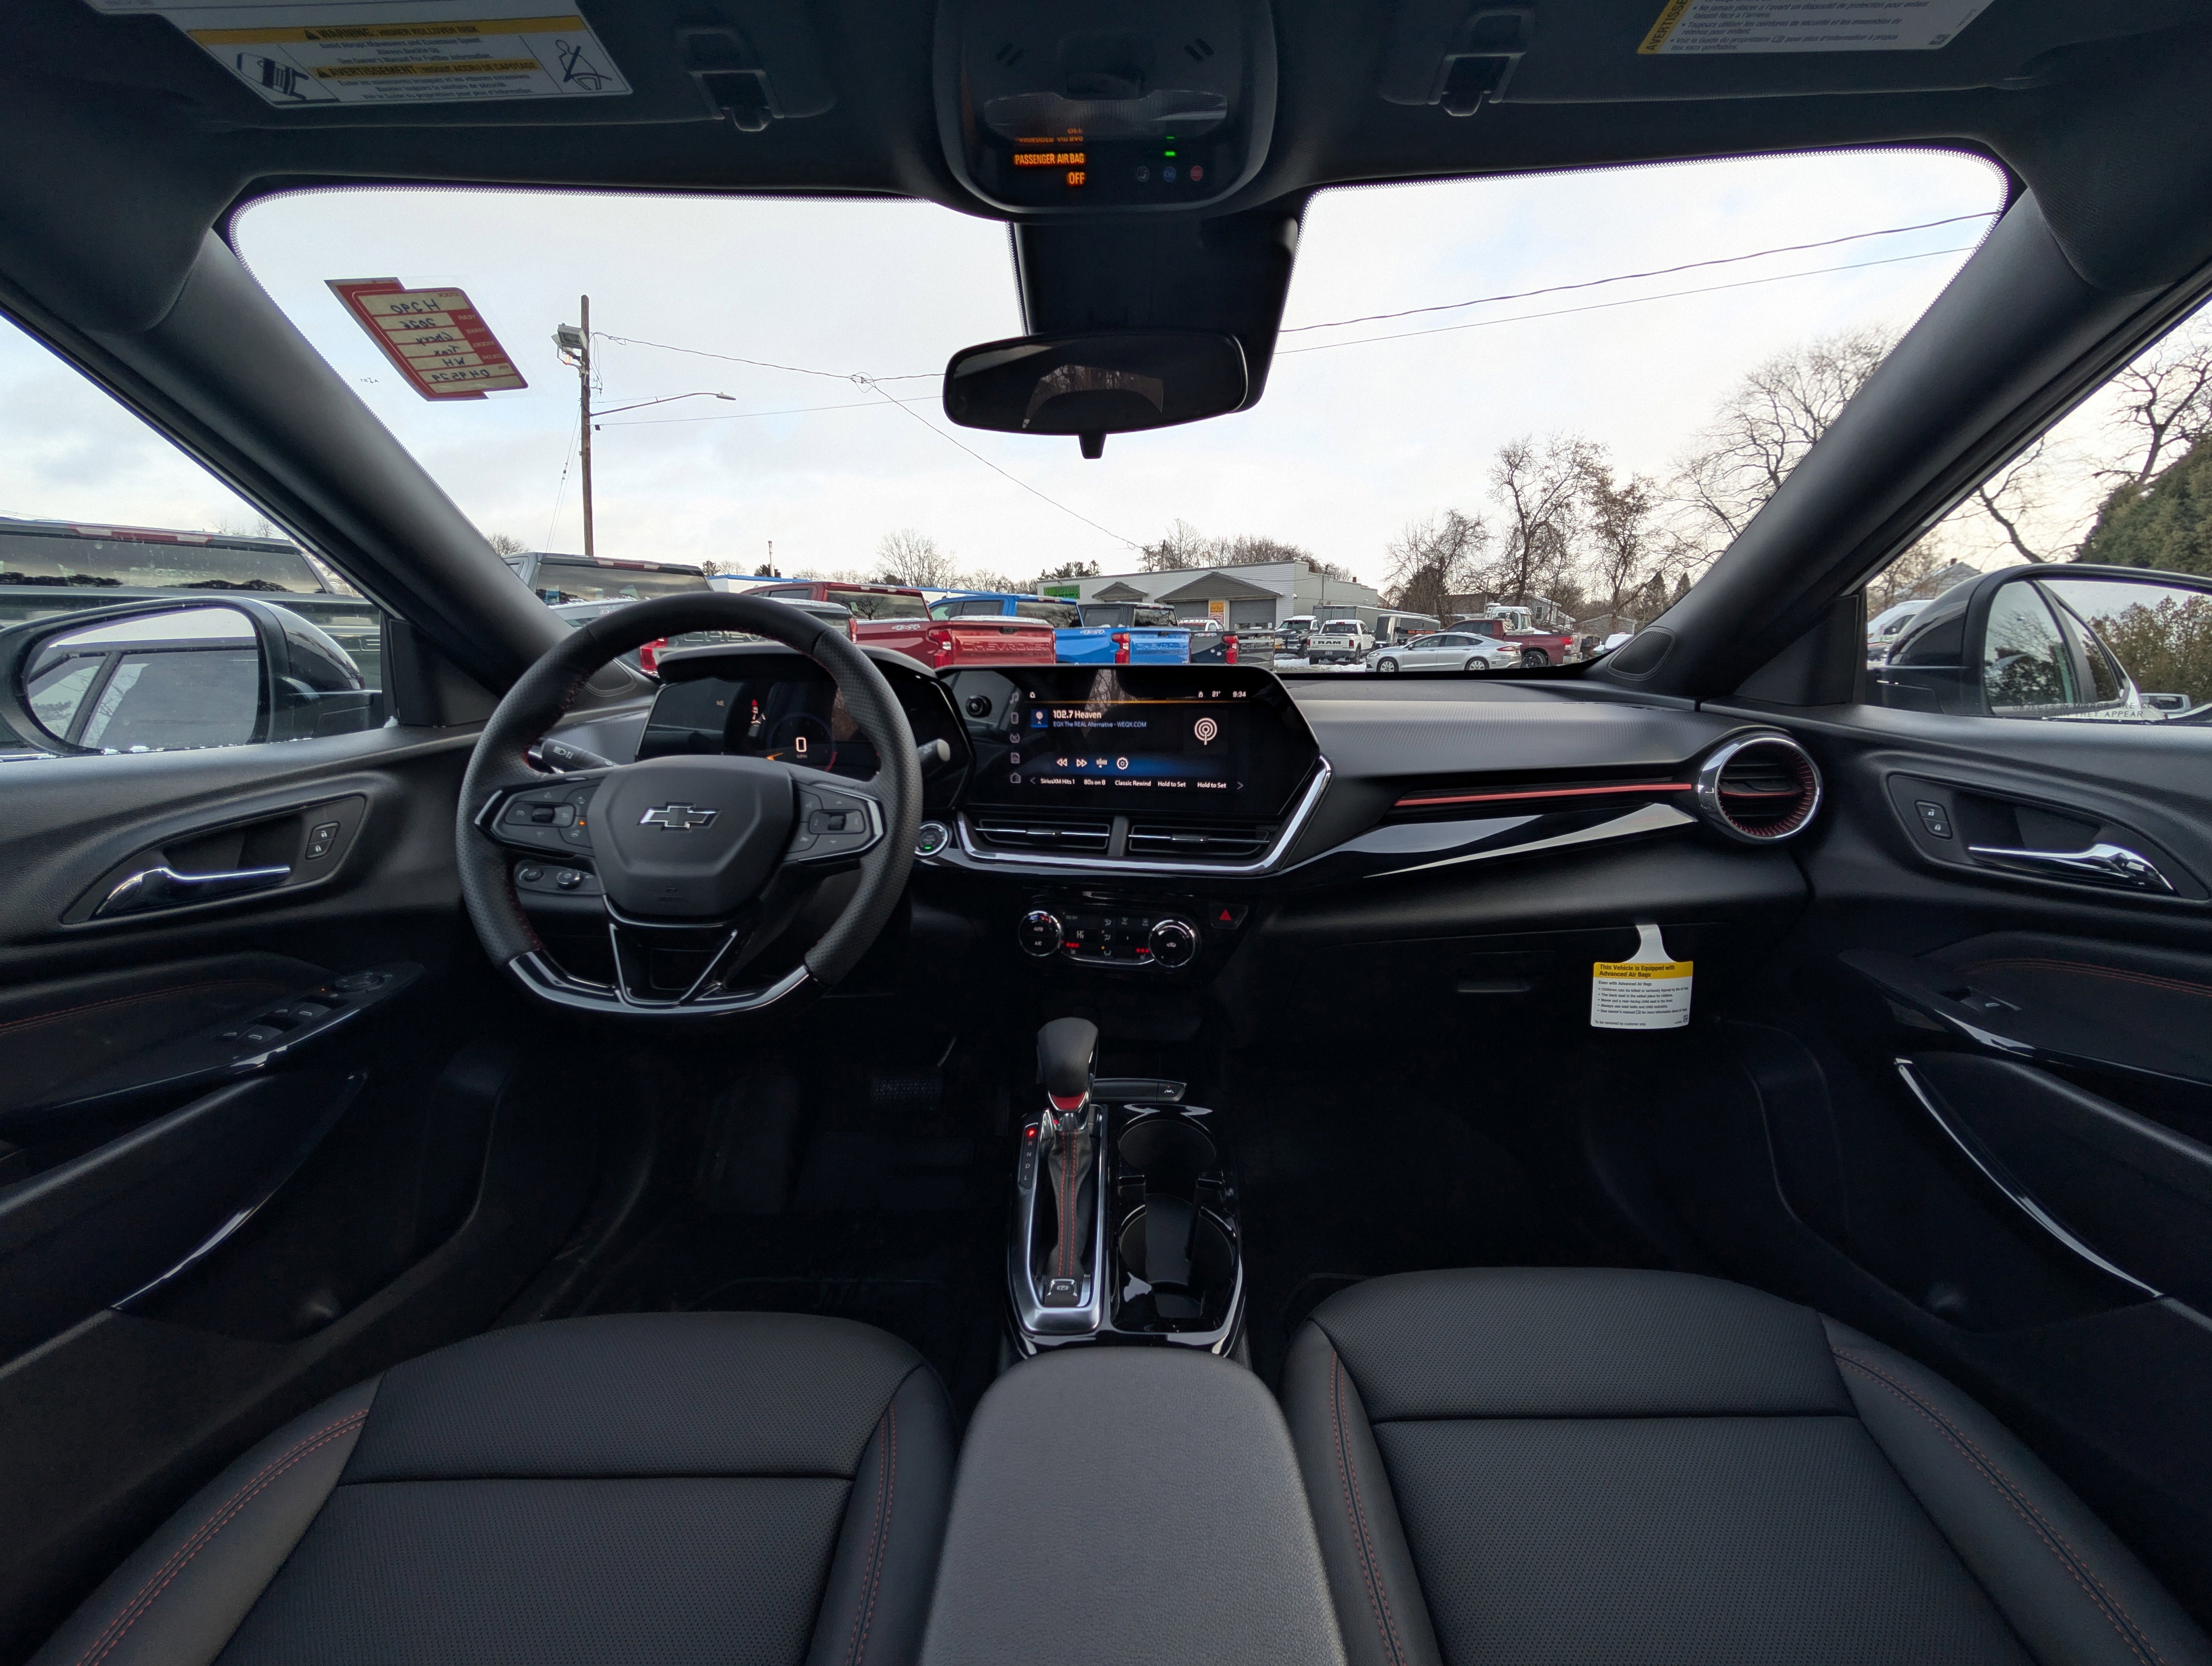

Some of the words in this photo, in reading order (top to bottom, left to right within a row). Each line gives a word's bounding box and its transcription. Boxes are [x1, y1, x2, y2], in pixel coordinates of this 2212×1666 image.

[1014, 154, 1055, 165] PASSENGER
[1057, 153, 1069, 164] AIR
[1070, 153, 1084, 163] BAG
[1069, 172, 1085, 184] OFF
[962, 642, 1049, 651] CHEVROLET
[1053, 710, 1073, 718] 102.7
[1075, 710, 1102, 718] Heaven
[1077, 930, 1084, 939] Hi
